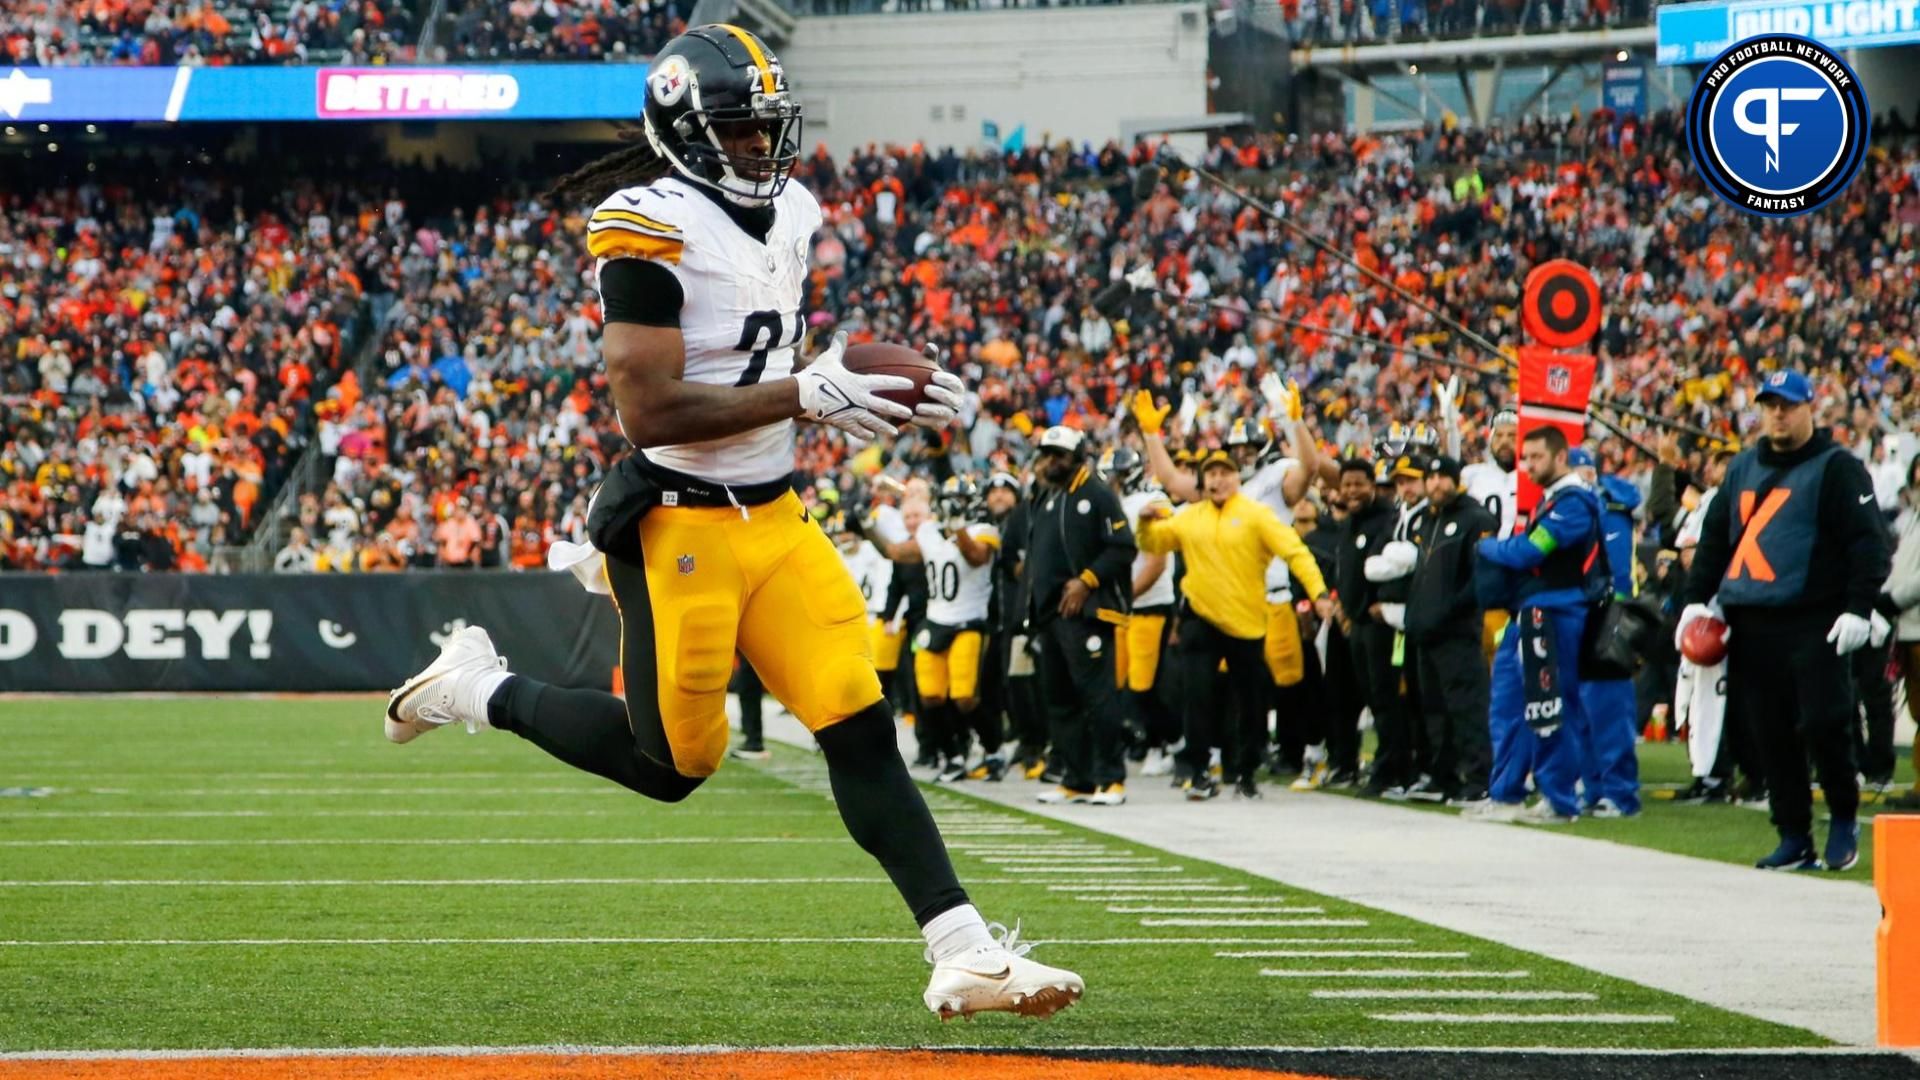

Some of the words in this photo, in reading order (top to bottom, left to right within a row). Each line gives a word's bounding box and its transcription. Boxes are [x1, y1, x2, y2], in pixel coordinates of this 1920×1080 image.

[1813, 0, 1918, 38] LIGHT
[324, 74, 519, 110] BETFRED
[1727, 488, 1792, 582] K
[57, 609, 273, 660] DEY!
